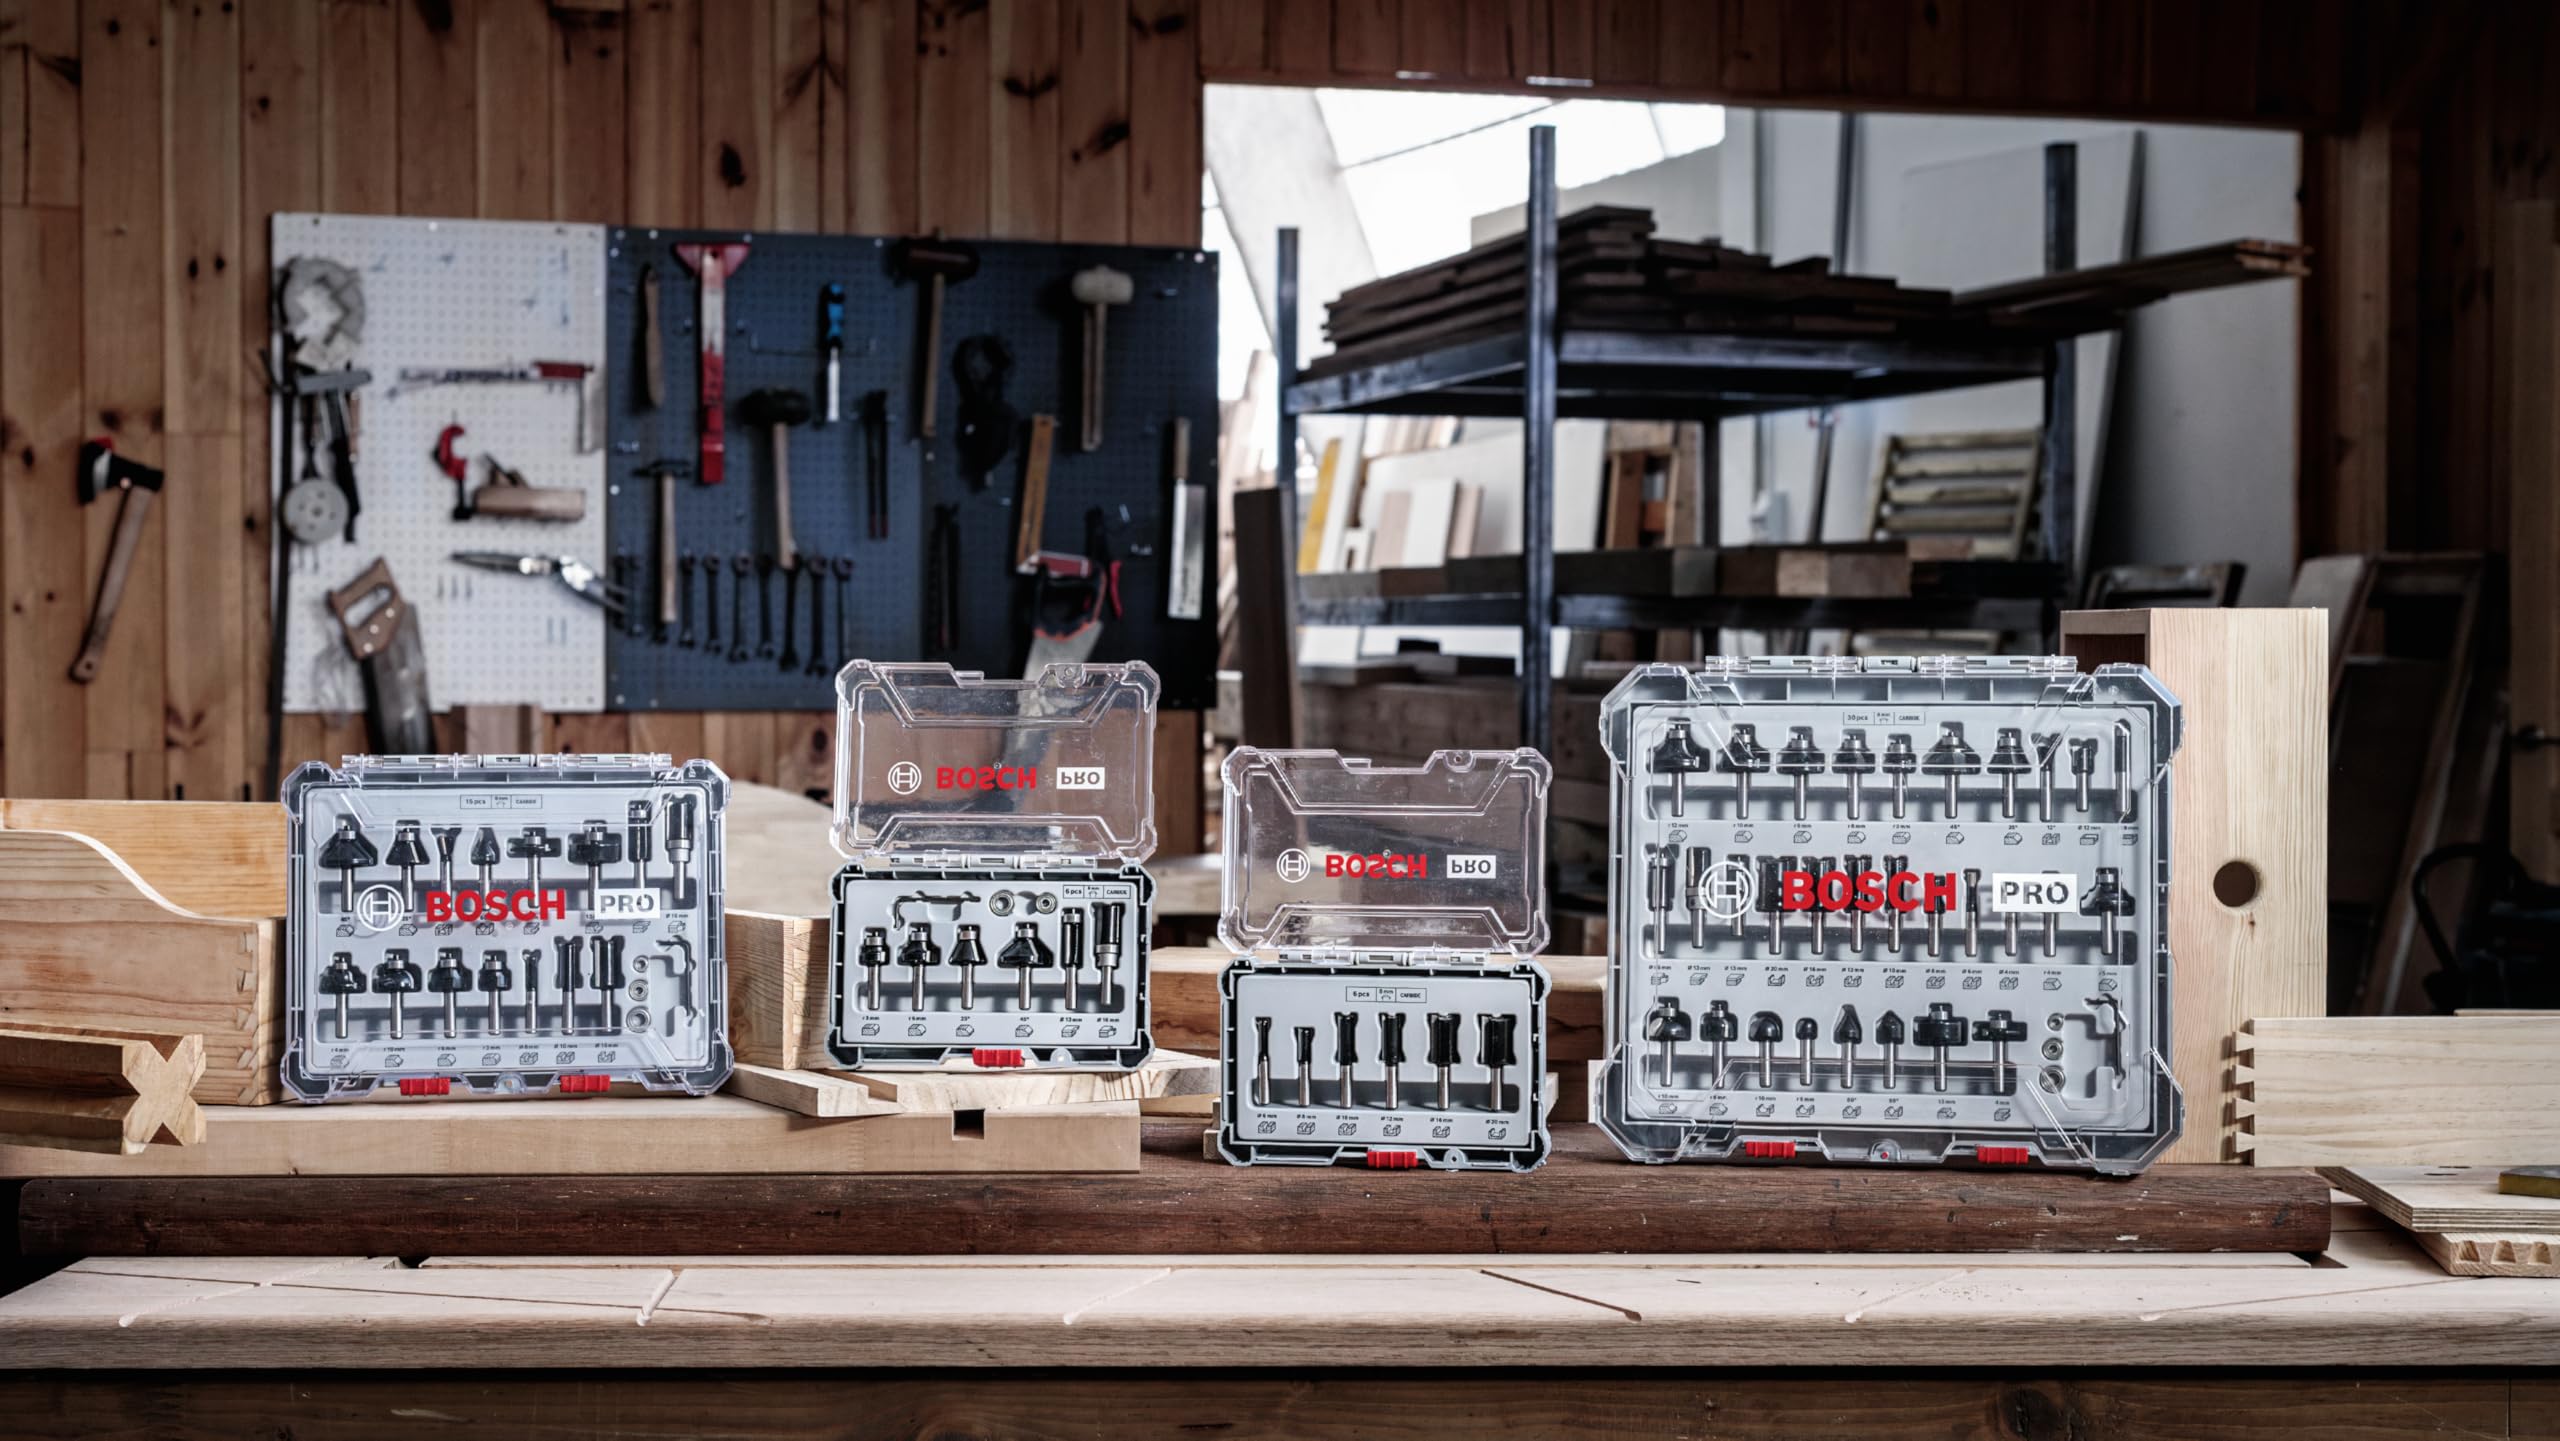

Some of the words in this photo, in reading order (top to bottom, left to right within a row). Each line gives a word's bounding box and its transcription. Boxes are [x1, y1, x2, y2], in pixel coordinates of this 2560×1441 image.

[426, 889, 565, 923] BOSCH
[600, 893, 655, 914] PRO
[1782, 871, 1956, 912] BOSCH
[2000, 881, 2069, 904] PRO
